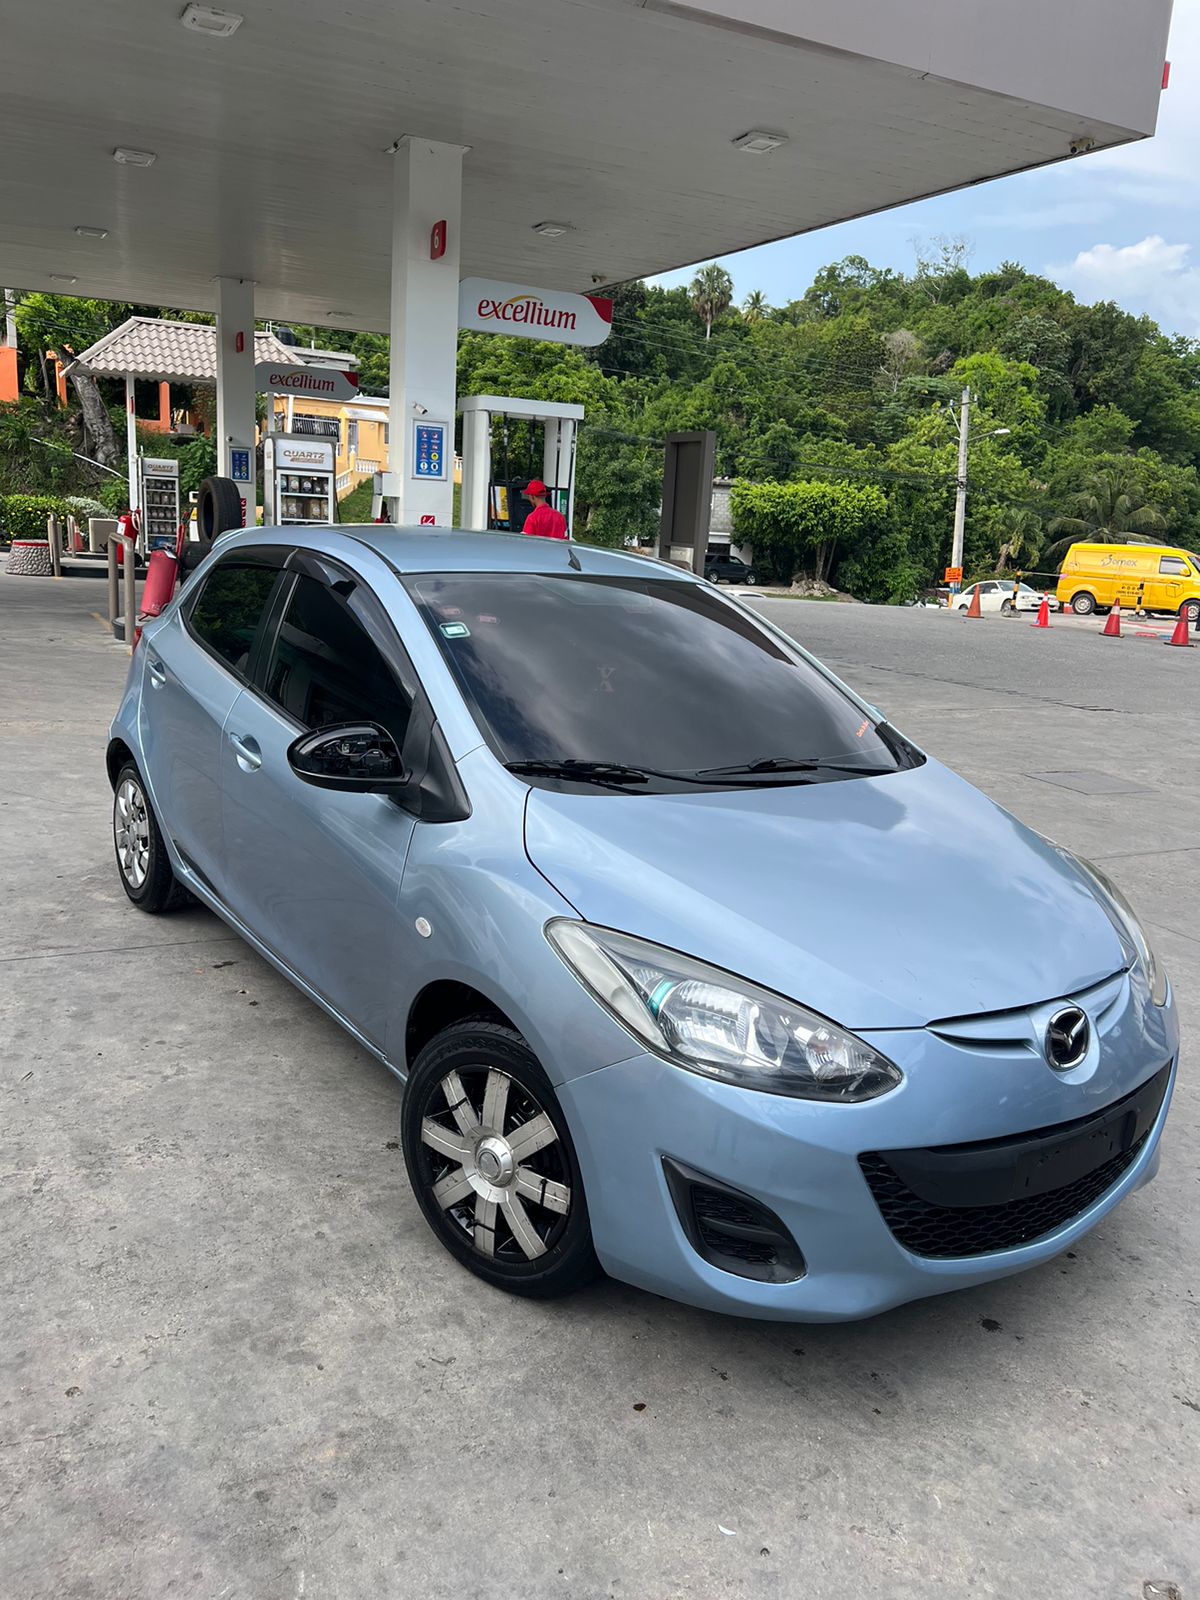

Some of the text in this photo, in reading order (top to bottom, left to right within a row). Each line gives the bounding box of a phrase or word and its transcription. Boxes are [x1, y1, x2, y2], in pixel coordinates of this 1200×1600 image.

[434, 228, 439, 249] 6
[477, 298, 576, 330] excellium
[269, 372, 335, 392] excellium
[283, 449, 326, 459] QUARTZ
